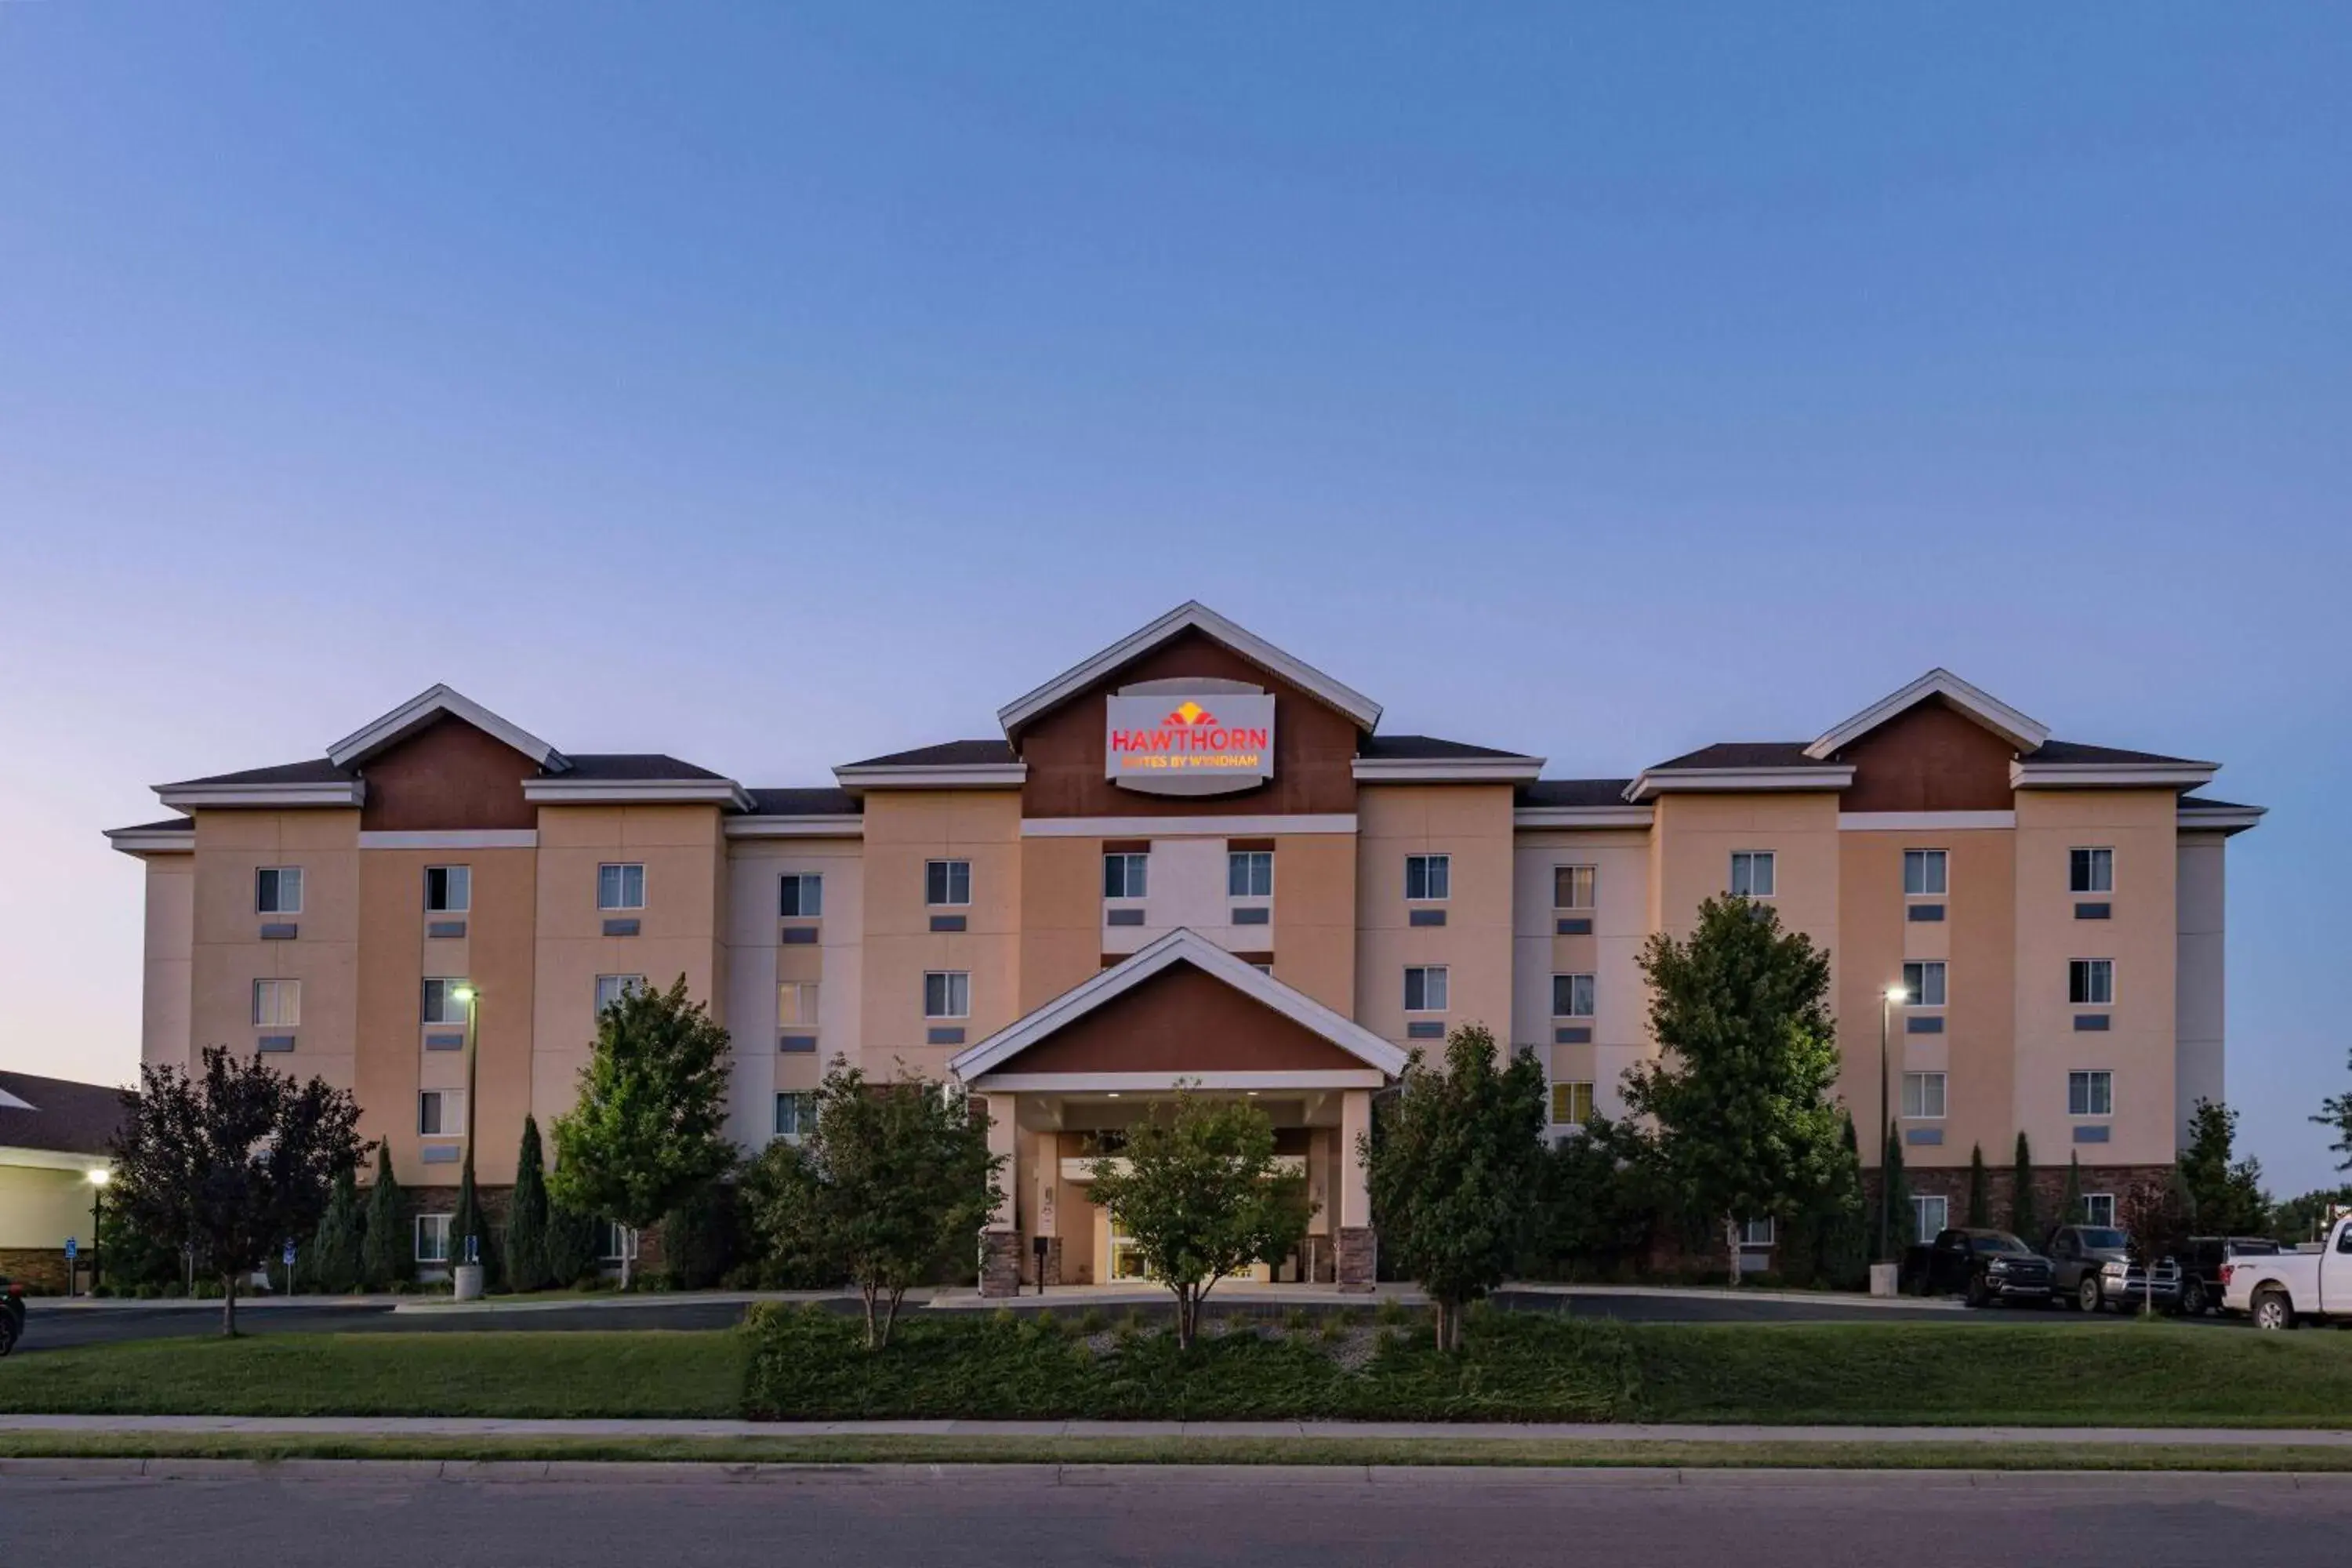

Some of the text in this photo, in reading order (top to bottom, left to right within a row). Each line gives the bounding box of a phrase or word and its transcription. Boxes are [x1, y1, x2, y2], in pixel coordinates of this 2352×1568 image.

[1112, 728, 1267, 752] HAWTHORN
[1123, 755, 1167, 768] TES
[1171, 755, 1187, 768] BY
